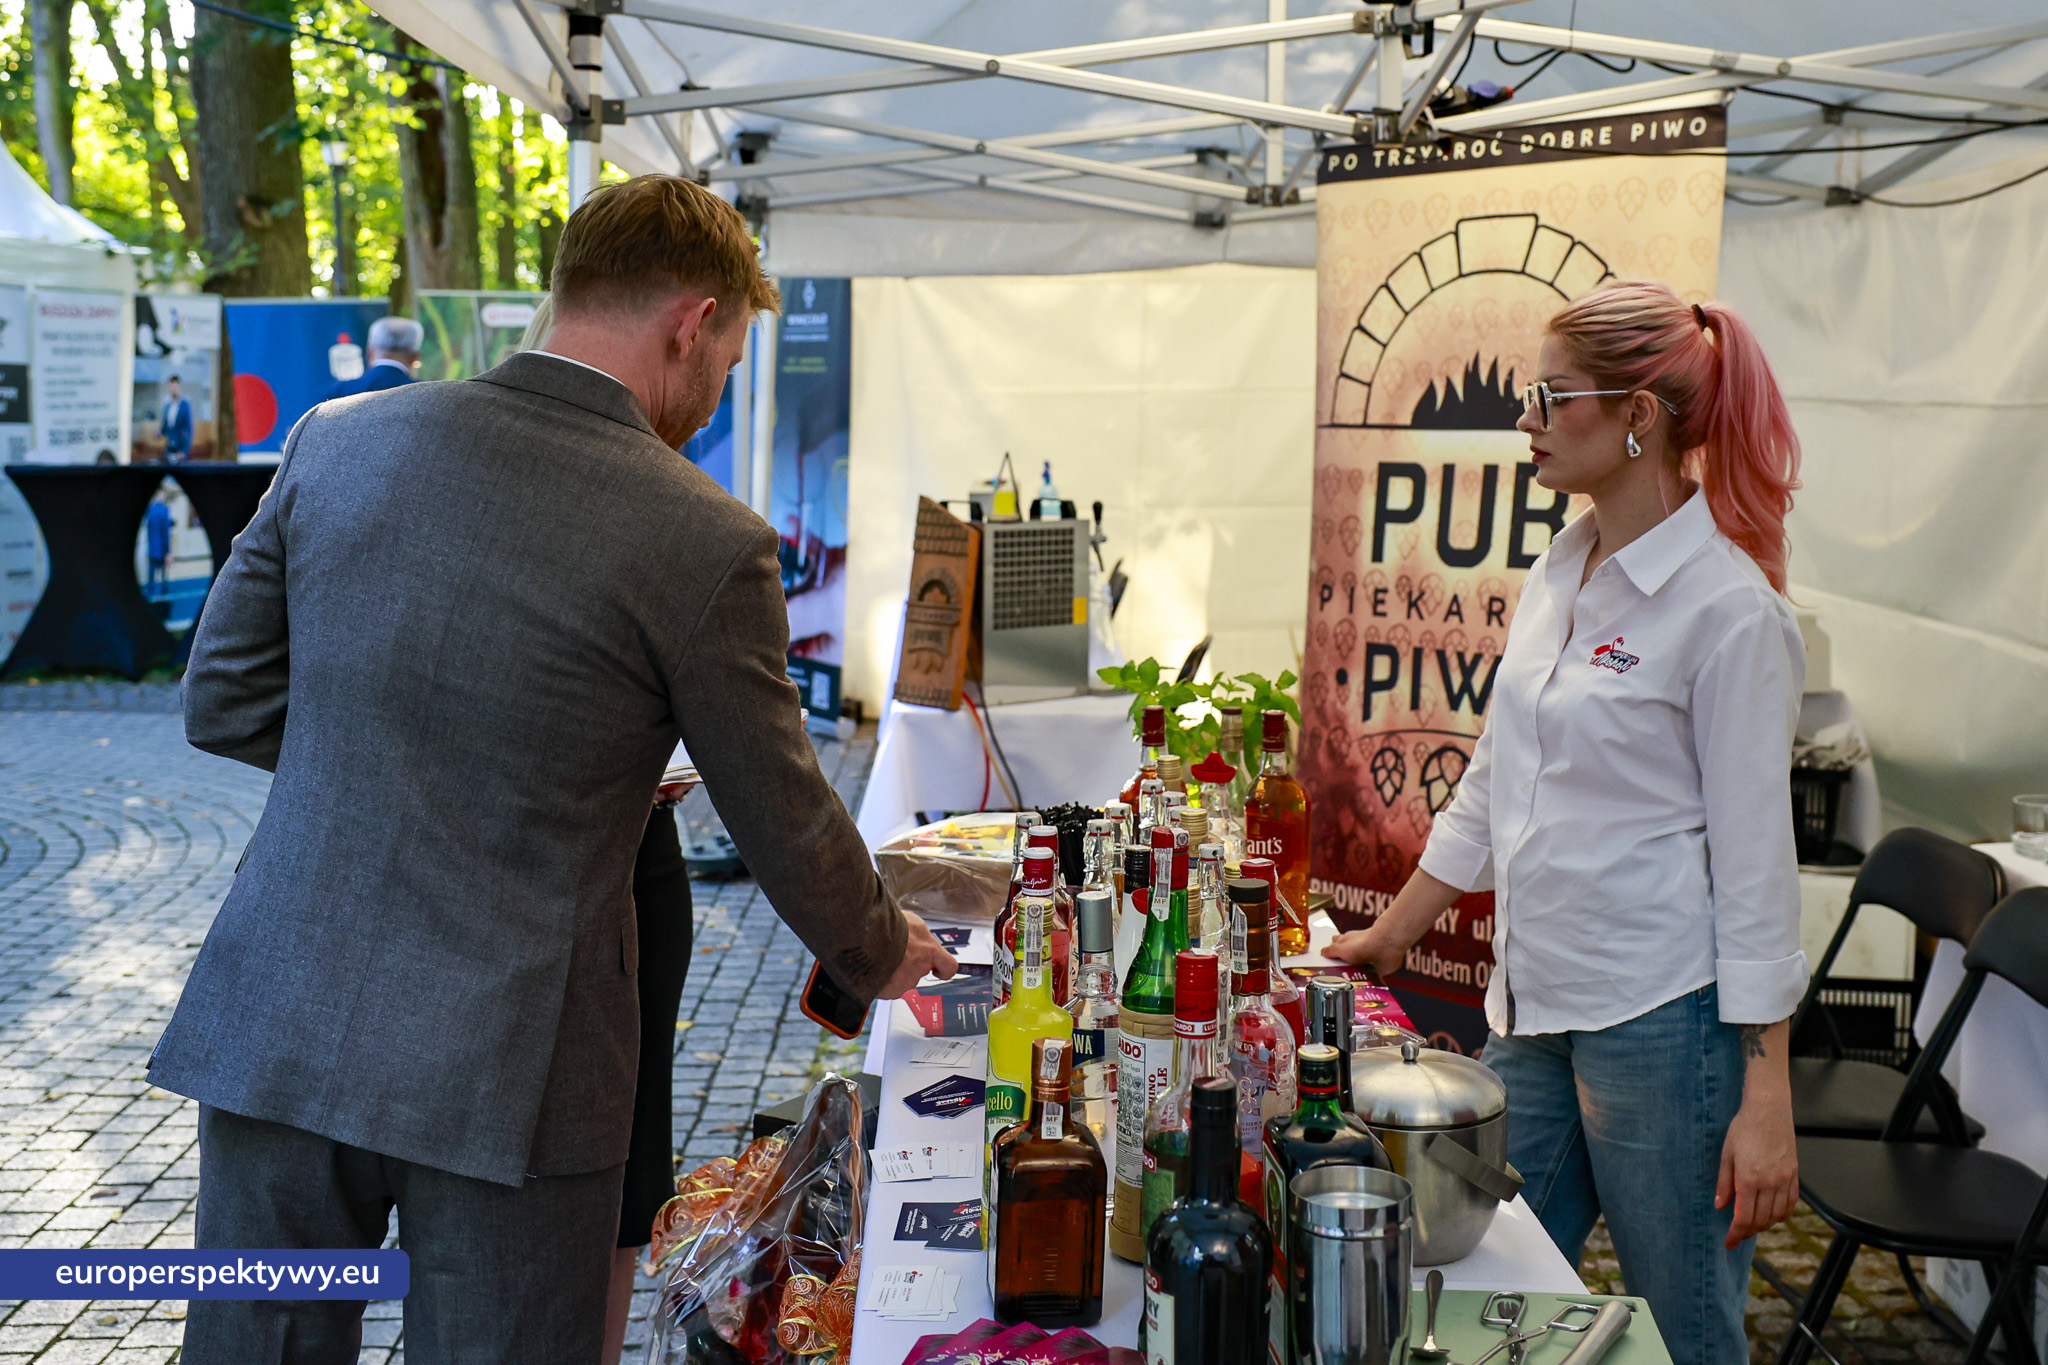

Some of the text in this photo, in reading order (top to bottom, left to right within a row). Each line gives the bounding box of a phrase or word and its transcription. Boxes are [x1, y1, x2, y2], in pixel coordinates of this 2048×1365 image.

[1327, 153, 1358, 173] PO
[1520, 126, 1613, 154] DOBRE
[1630, 116, 1707, 142] PIWO
[1371, 462, 1570, 569] PUB
[1405, 946, 1472, 985] klubem
